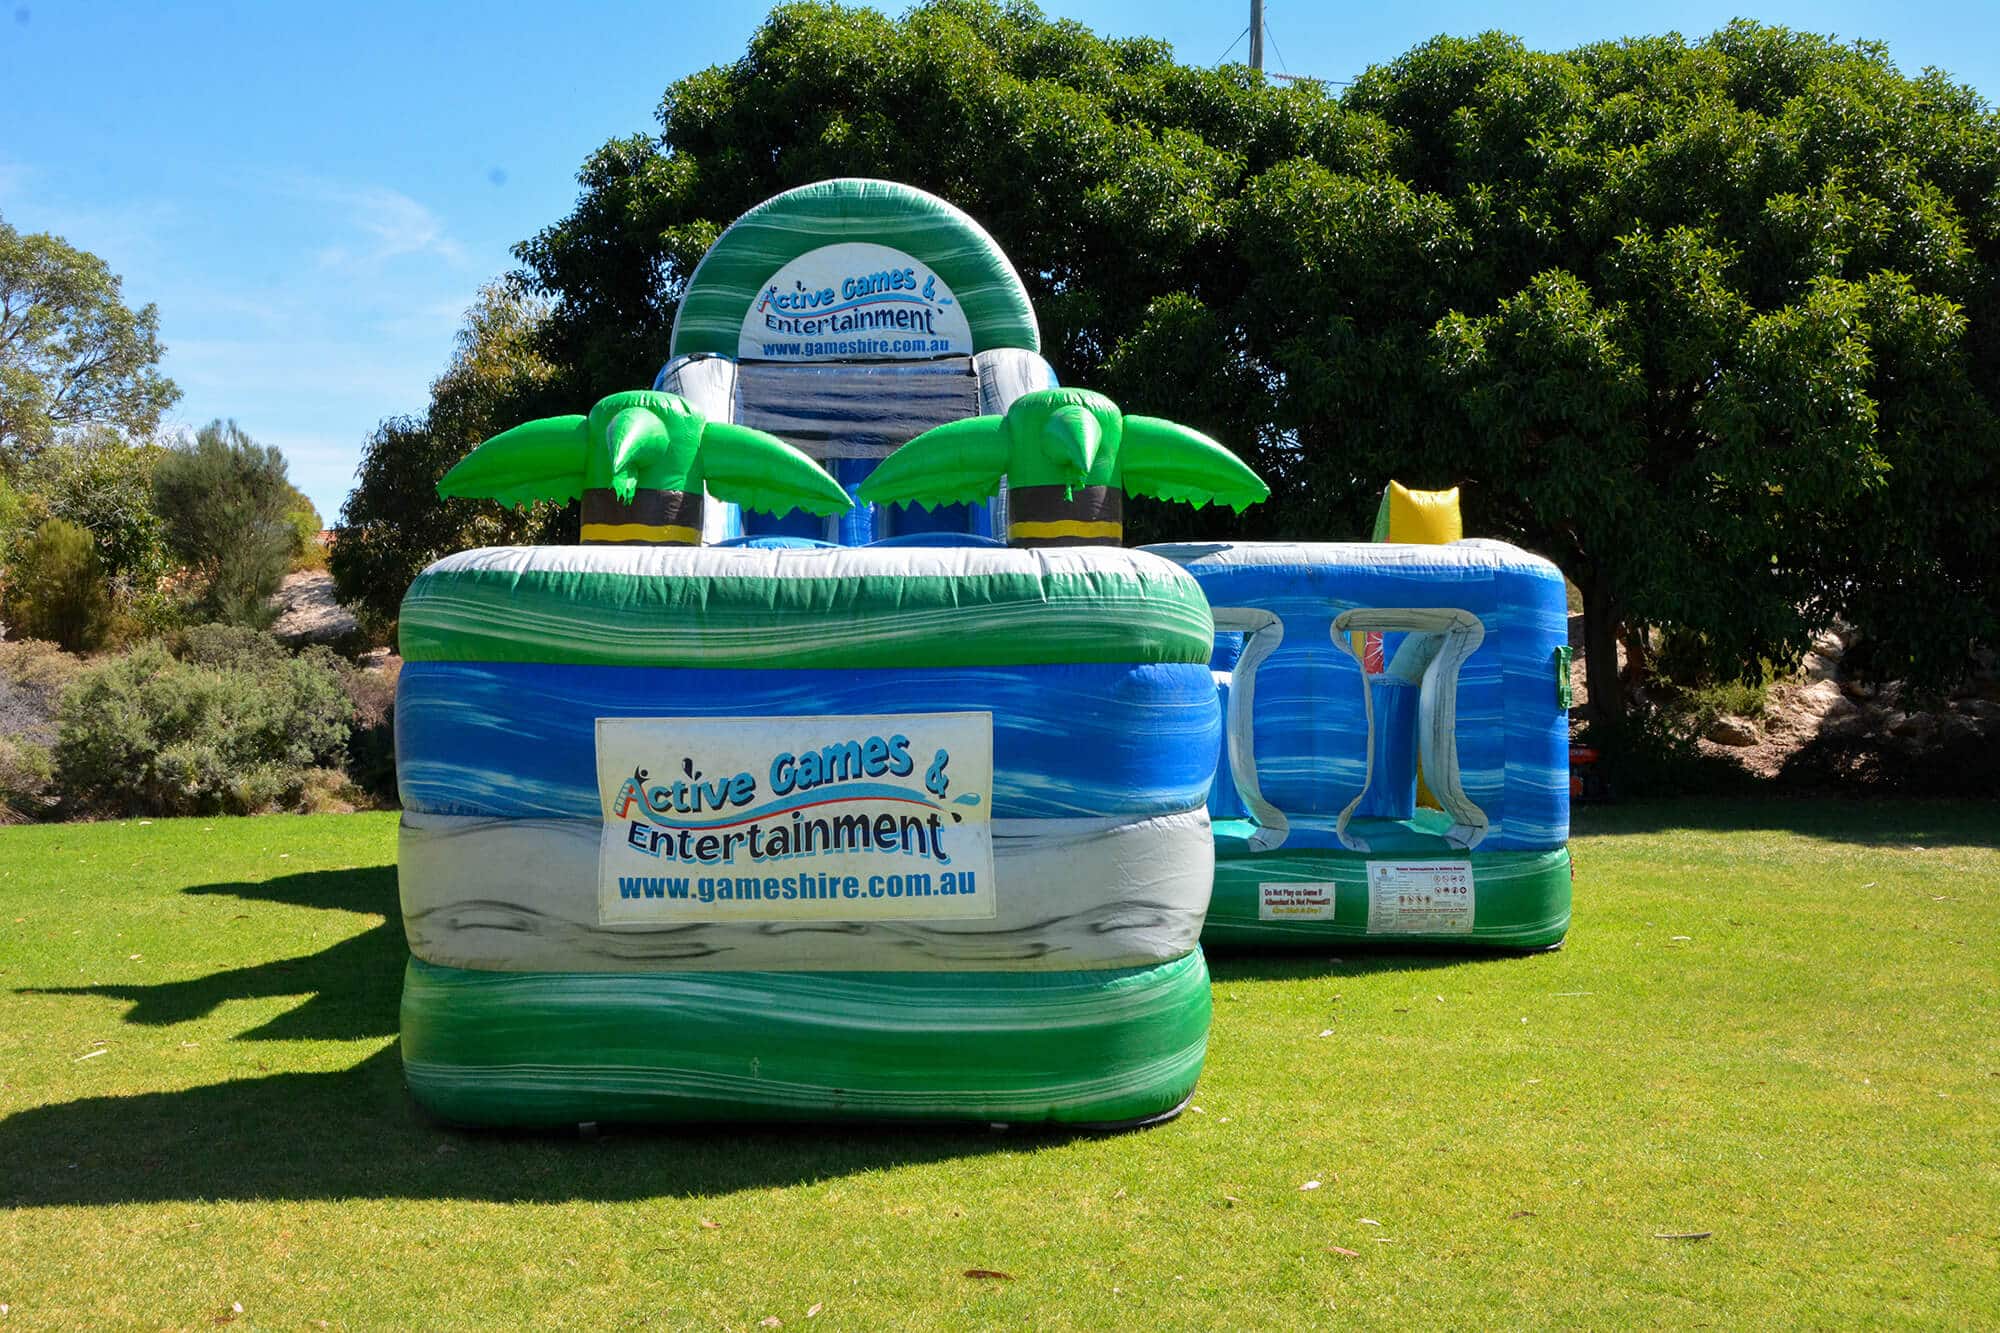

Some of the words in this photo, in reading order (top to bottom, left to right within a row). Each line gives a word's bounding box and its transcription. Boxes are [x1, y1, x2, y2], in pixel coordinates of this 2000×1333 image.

[757, 283, 834, 314] Active
[841, 267, 917, 300] Games
[921, 275, 936, 301] &
[765, 306, 938, 336] Entertainment
[763, 338, 950, 357] www.gameshire.com.au
[613, 762, 756, 818] Active
[769, 733, 914, 797] Games
[924, 748, 950, 799] &
[628, 811, 952, 866] Entertainment
[618, 870, 976, 902] www.gameshire.com.au
[1264, 888, 1272, 896] Do
[1273, 888, 1282, 896] Not
[1283, 888, 1294, 898] Play
